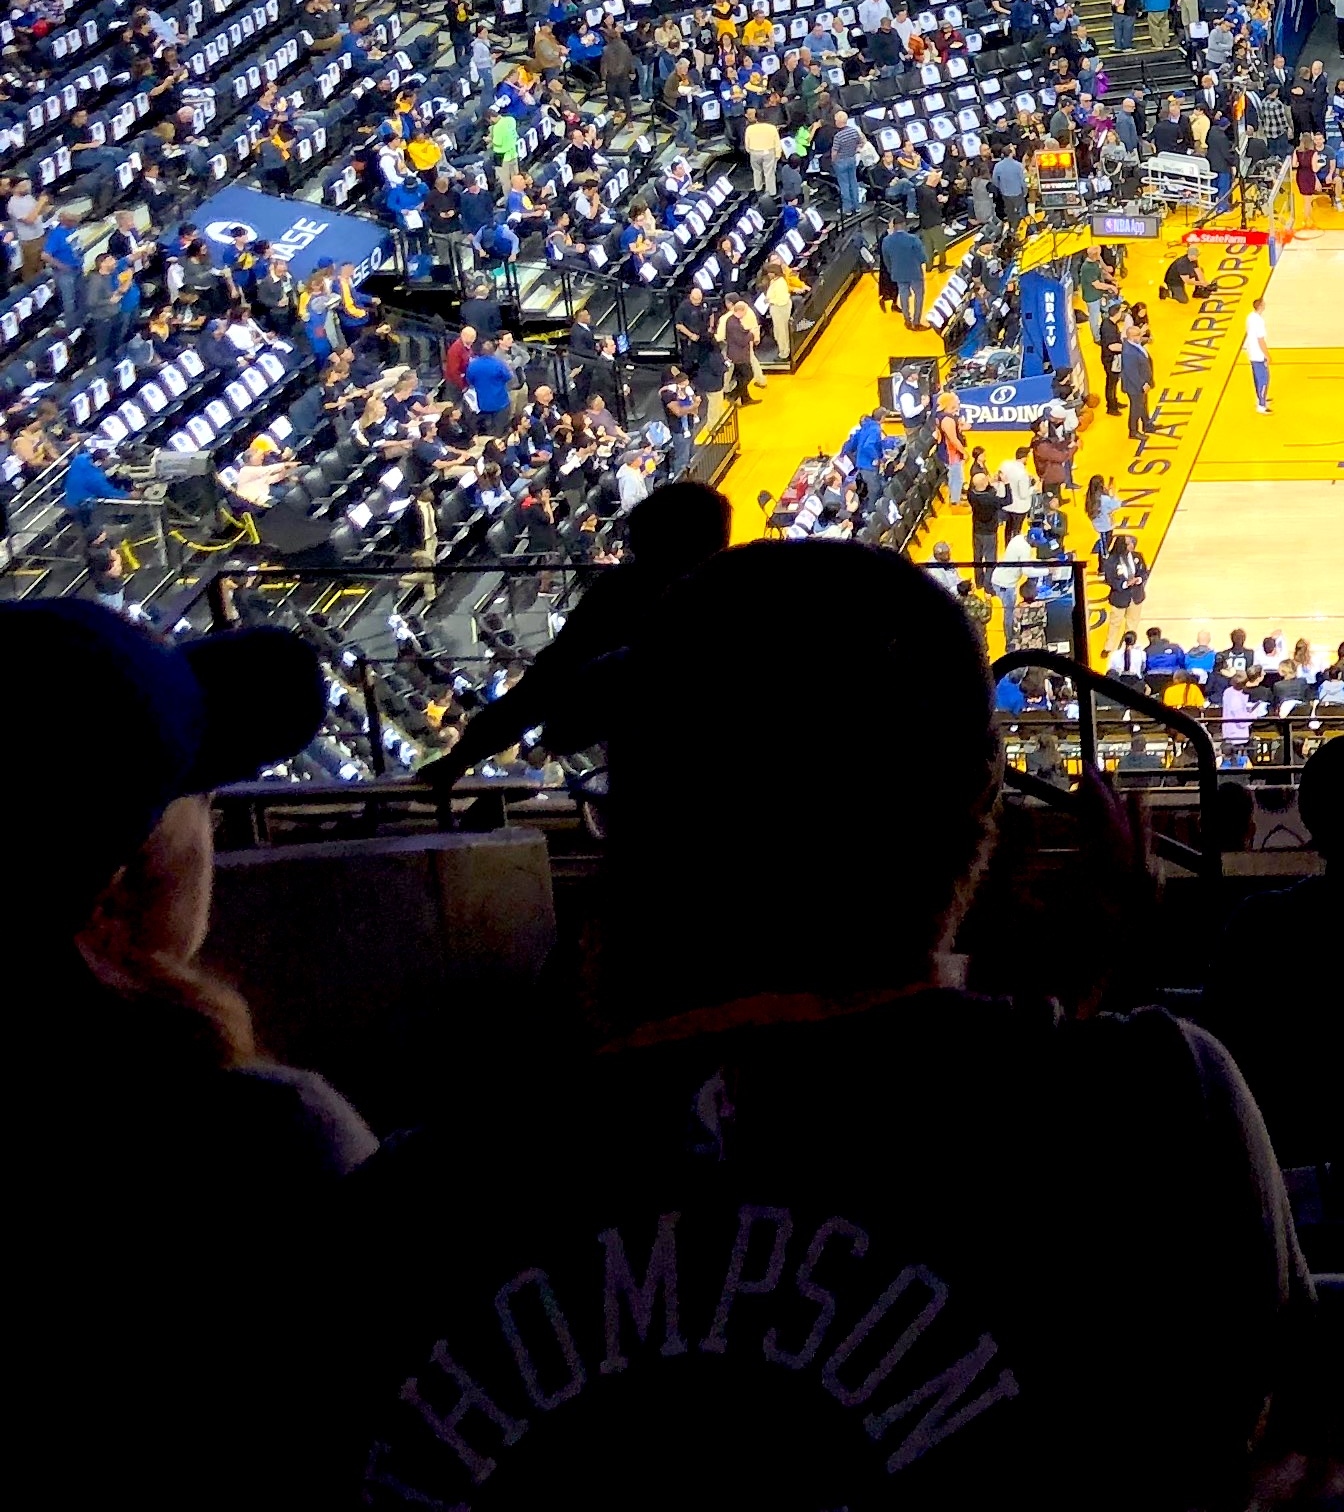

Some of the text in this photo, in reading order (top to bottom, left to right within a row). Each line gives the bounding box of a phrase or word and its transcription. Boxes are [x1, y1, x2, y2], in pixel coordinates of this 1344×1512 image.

[1113, 218, 1146, 235] NBA App
[1043, 291, 1057, 347] NBA TV
[1170, 243, 1262, 379] WARRIORS
[360, 1202, 1023, 1512] THOMPSON
